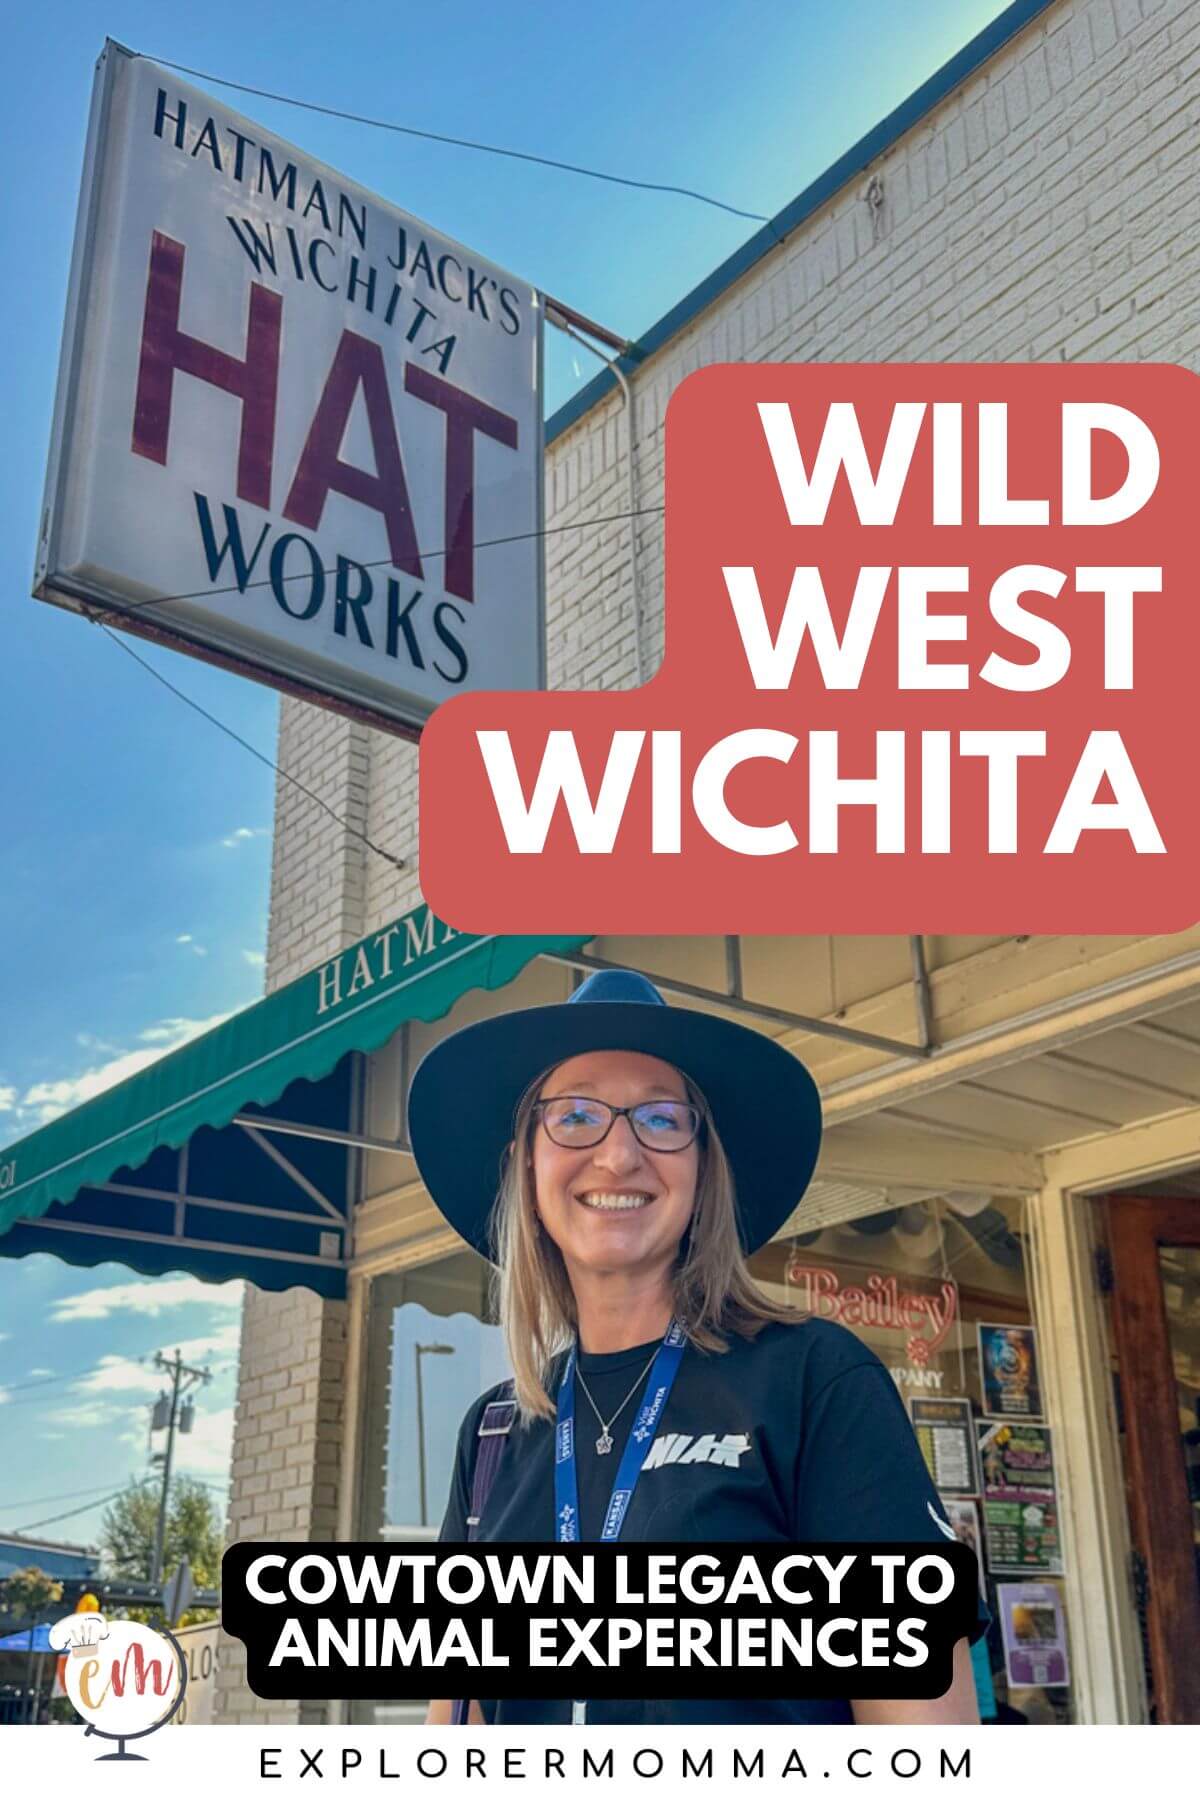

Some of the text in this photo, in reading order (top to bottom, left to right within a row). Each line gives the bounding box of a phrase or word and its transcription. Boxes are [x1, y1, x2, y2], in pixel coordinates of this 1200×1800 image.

[153, 88, 521, 336] HATMAN JACK'S
[226, 216, 456, 375] WICHITA
[131, 229, 519, 604] HAT
[193, 491, 469, 684] WORKS
[789, 1267, 956, 1367] Bailey
[605, 1493, 624, 1537] KANSAS
